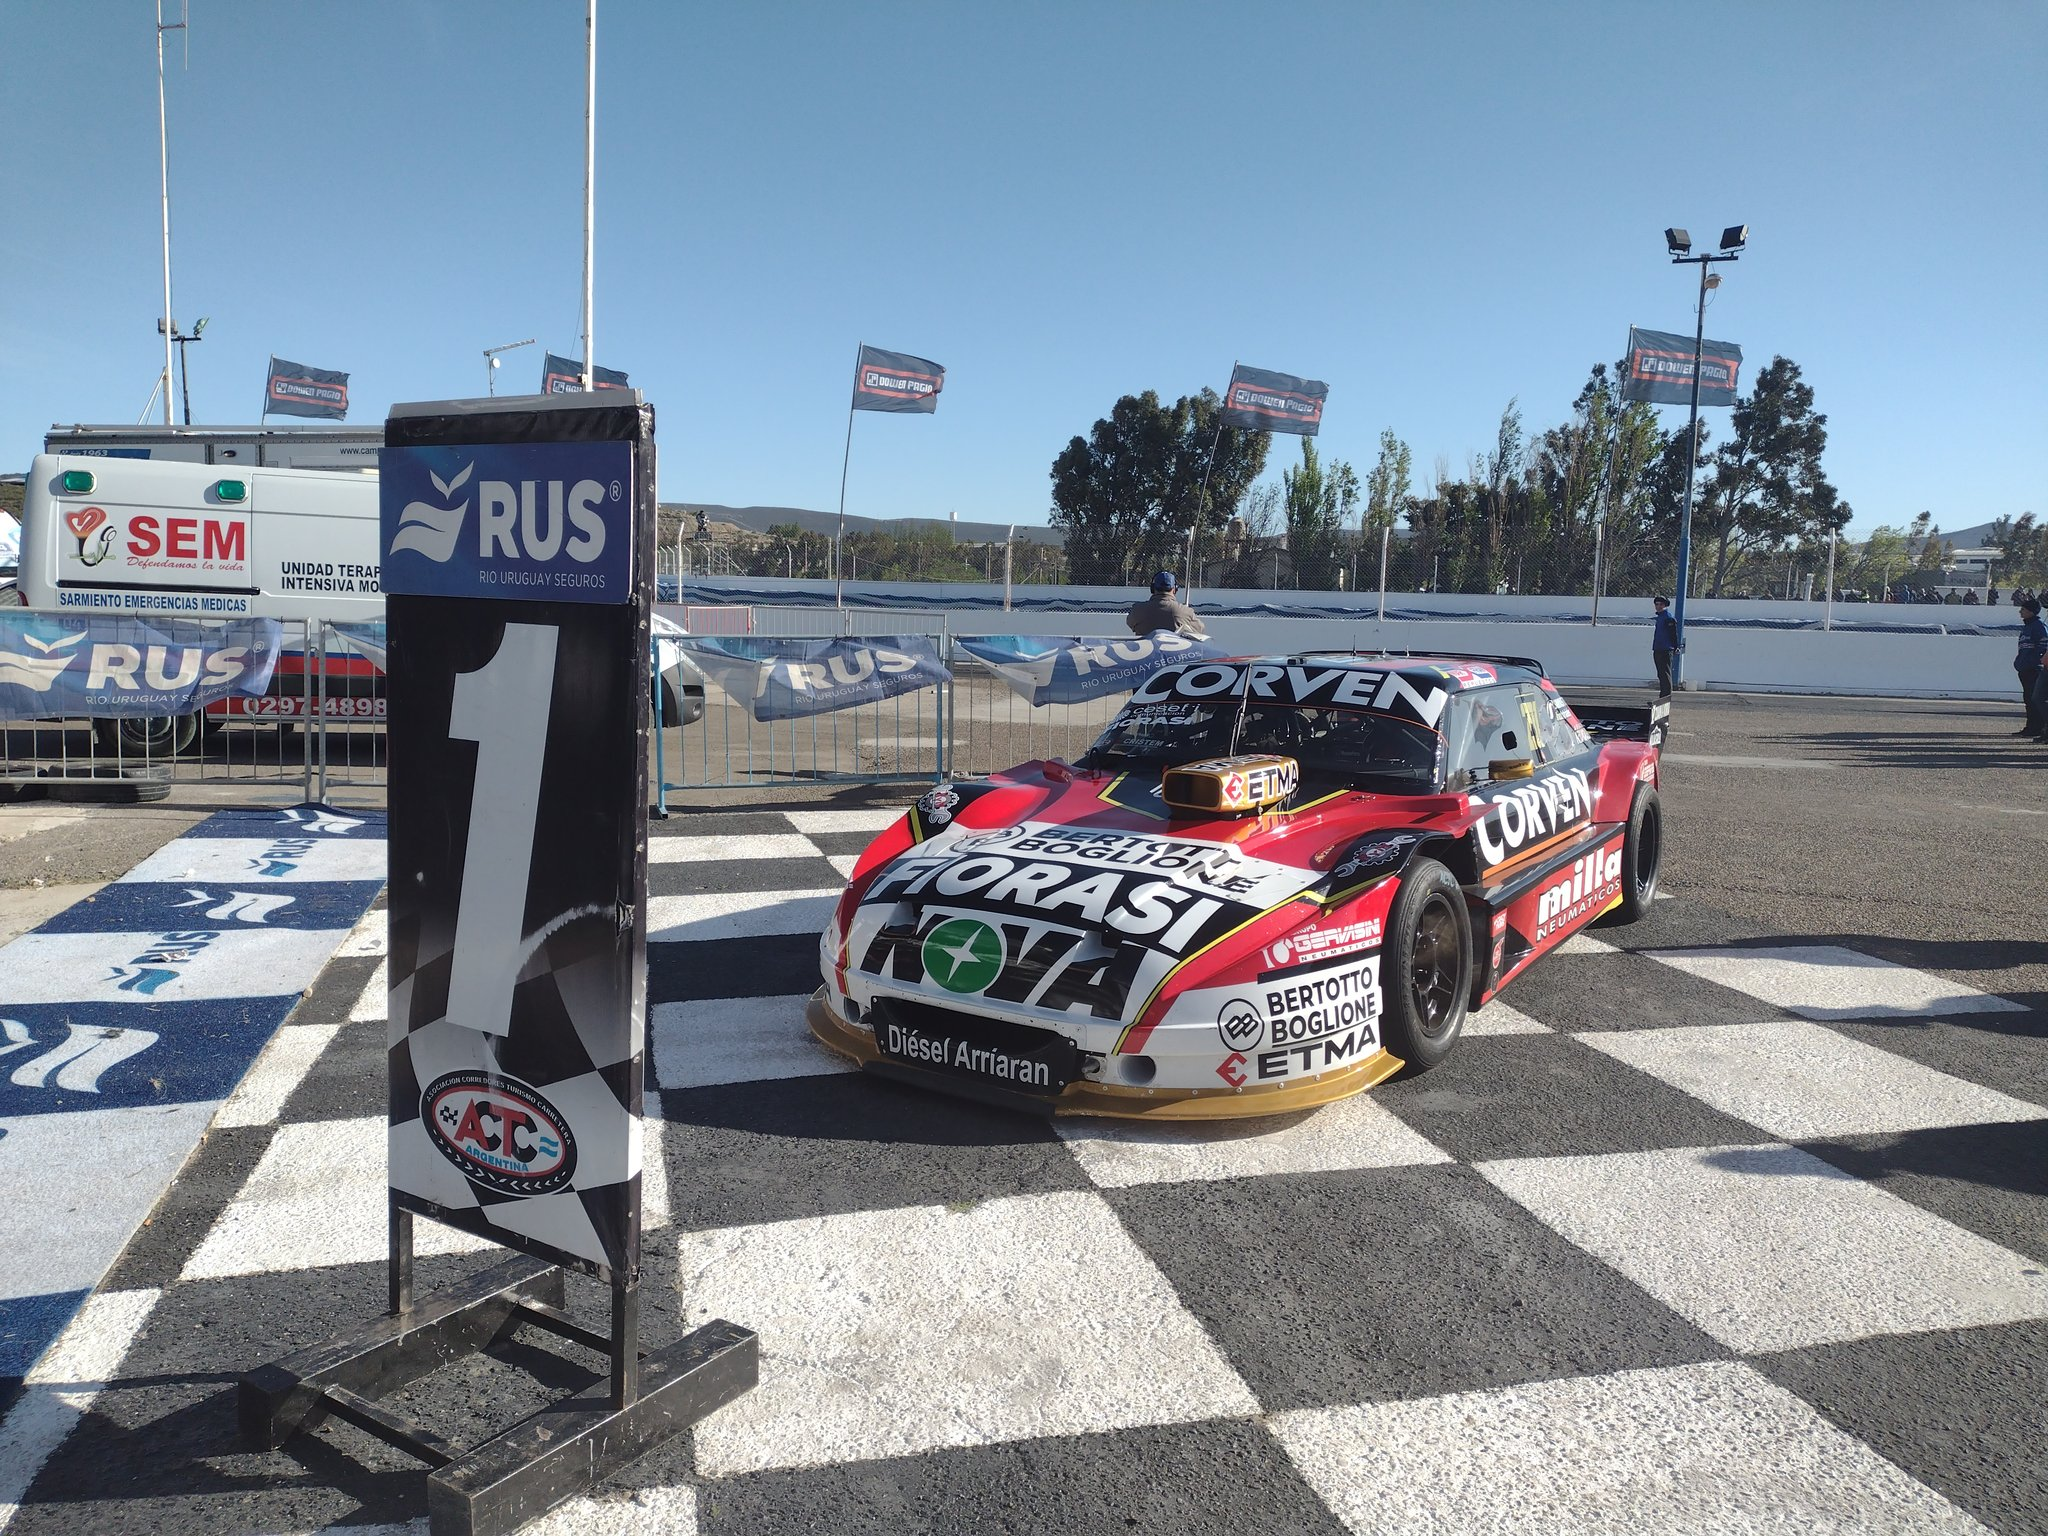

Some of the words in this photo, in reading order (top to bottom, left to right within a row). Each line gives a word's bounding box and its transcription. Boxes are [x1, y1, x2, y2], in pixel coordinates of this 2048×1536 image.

[127, 515, 245, 561] SEM
[479, 479, 606, 563] RUS
[127, 556, 197, 569] Defendamos
[202, 561, 214, 570] la
[219, 562, 244, 571] vida
[282, 562, 333, 576] UNIDAD
[338, 564, 380, 578] TERAP
[282, 577, 354, 592] INTENSIVA
[479, 571, 497, 583] RIO
[500, 572, 551, 586] URUGUAY
[554, 573, 605, 588] SEGUROS
[60, 592, 121, 608] SARMIENTO
[125, 595, 198, 610] EMERGENCIAS
[202, 598, 247, 612] MEDICAS
[86, 644, 249, 690] RUS
[795, 695, 813, 704] RIO
[815, 684, 869, 700] URUGUAY
[873, 672, 923, 689] SEGUROS
[1081, 678, 1100, 690] RIO
[1102, 663, 1151, 684] URUGUAY
[1154, 651, 1202, 668] SEGUROS
[86, 696, 107, 704] RIO
[112, 694, 177, 704] URUGUAY
[1132, 664, 1449, 728] CORVEN
[1249, 761, 1299, 801] ETMA
[445, 622, 559, 1037] 1
[1469, 768, 1591, 866] CORVEN
[864, 857, 1224, 953] FIORASI
[1538, 847, 1622, 925] milla
[1536, 879, 1621, 941] NEUMATICOS
[1301, 937, 1380, 961] NEUMATICOS
[1267, 967, 1373, 1017] BERTOTTO
[1271, 993, 1377, 1044] BOGLIONE
[889, 1024, 950, 1065] Diésel
[1257, 1024, 1377, 1080] ETMA
[507, 1084, 536, 1104] TURISMO
[537, 1100, 572, 1145] CARRETERA
[465, 1145, 529, 1171] ARGENTINA
